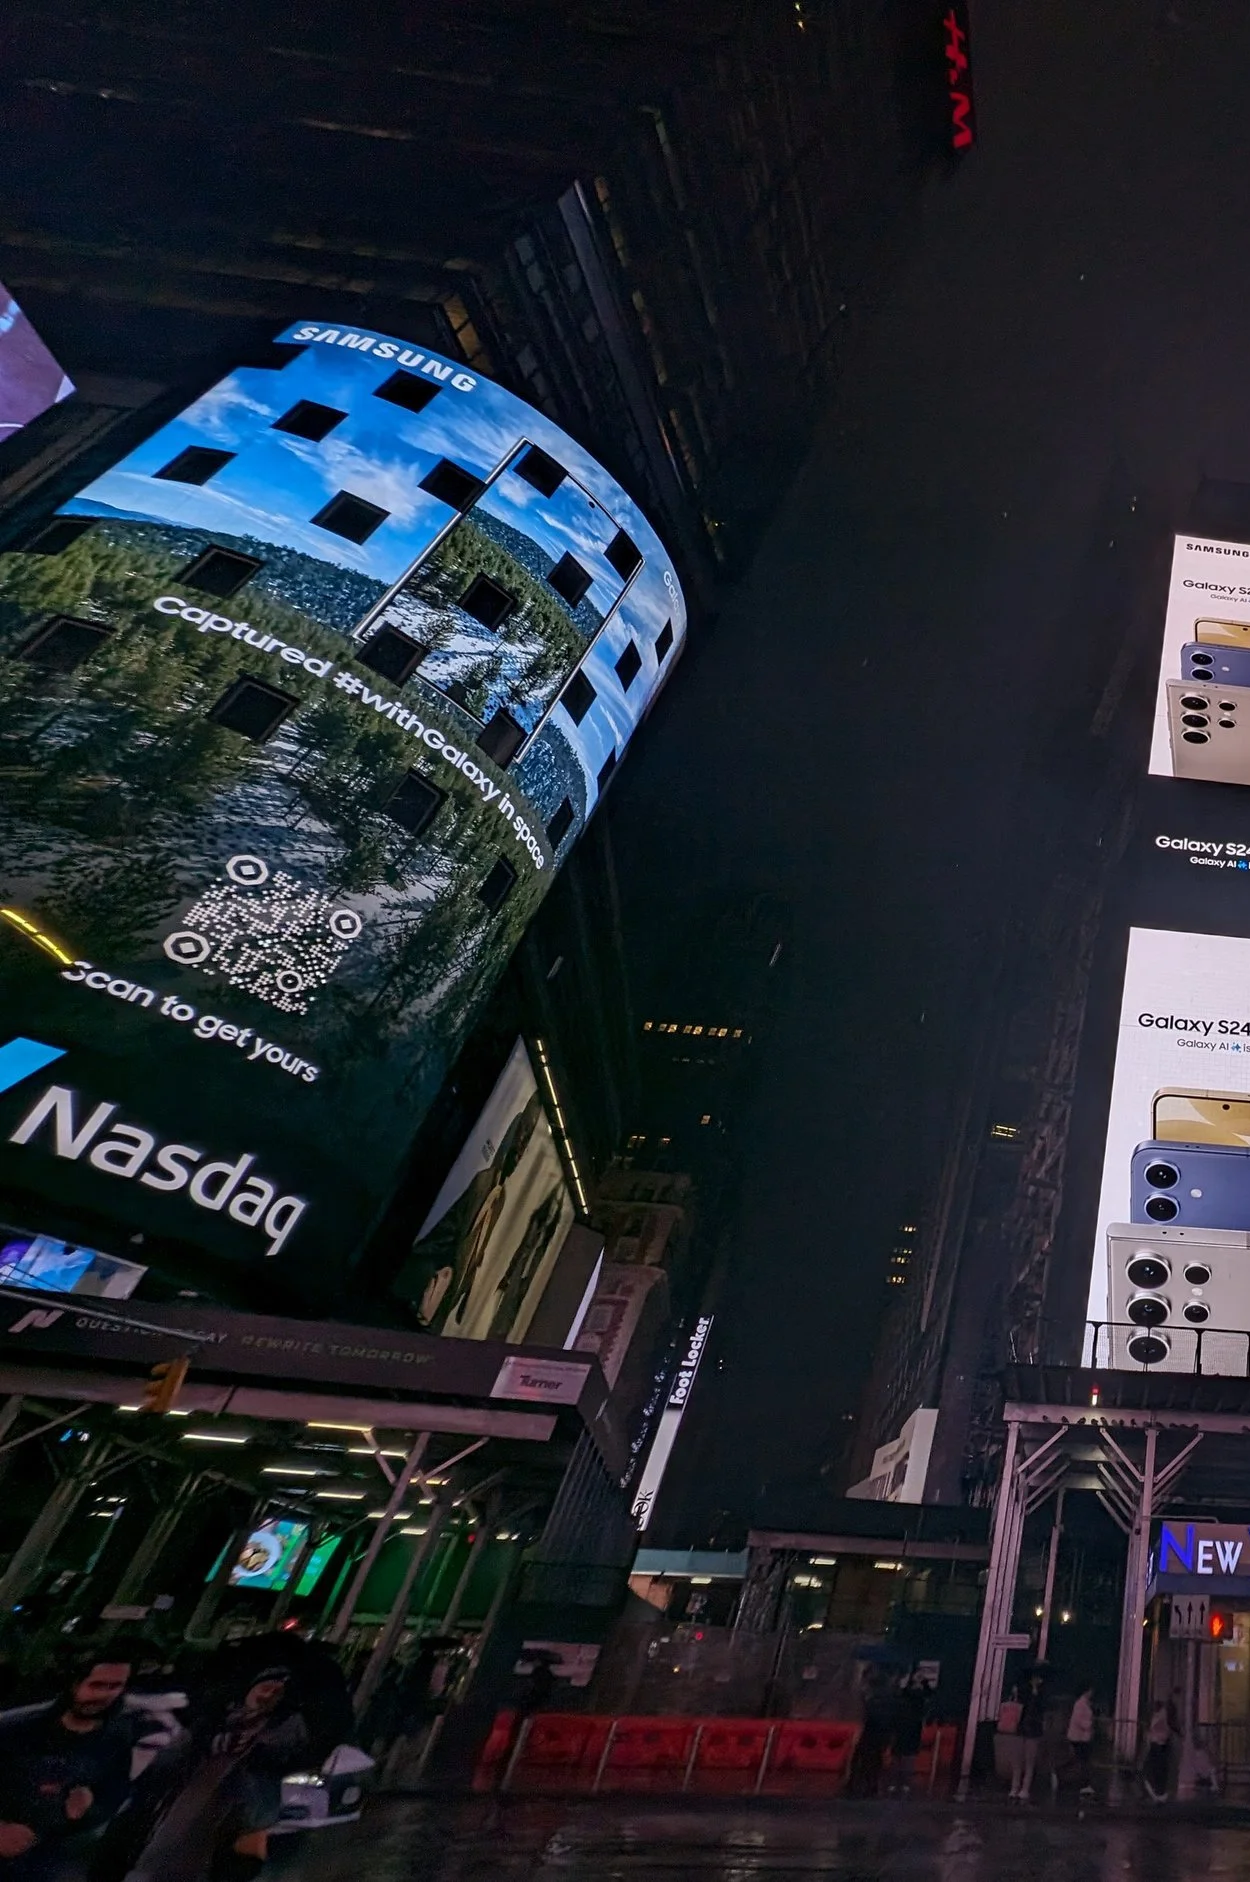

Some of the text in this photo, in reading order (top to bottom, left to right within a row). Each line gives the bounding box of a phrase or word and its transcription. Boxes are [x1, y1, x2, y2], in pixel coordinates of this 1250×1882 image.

[292, 326, 477, 393] SAMSUNG
[1186, 543, 1250, 558] SAMSUNG
[1183, 579, 1236, 595] Galaxy
[1210, 593, 1239, 603] Galaxy
[153, 596, 545, 870] Captured #withGalaxy in space
[1155, 835, 1223, 857] Galaxy
[1189, 856, 1226, 869] Galaxy
[1226, 859, 1237, 869] AI
[61, 960, 321, 1083] Scan to get yours
[1138, 1012, 1215, 1036] Galaxy
[1176, 1038, 1217, 1051] Galaxy
[1218, 1041, 1230, 1051] AI
[8, 1084, 307, 1258] Nasdaq
[669, 1315, 711, 1406] Foot Locker
[519, 1374, 563, 1390] Turner
